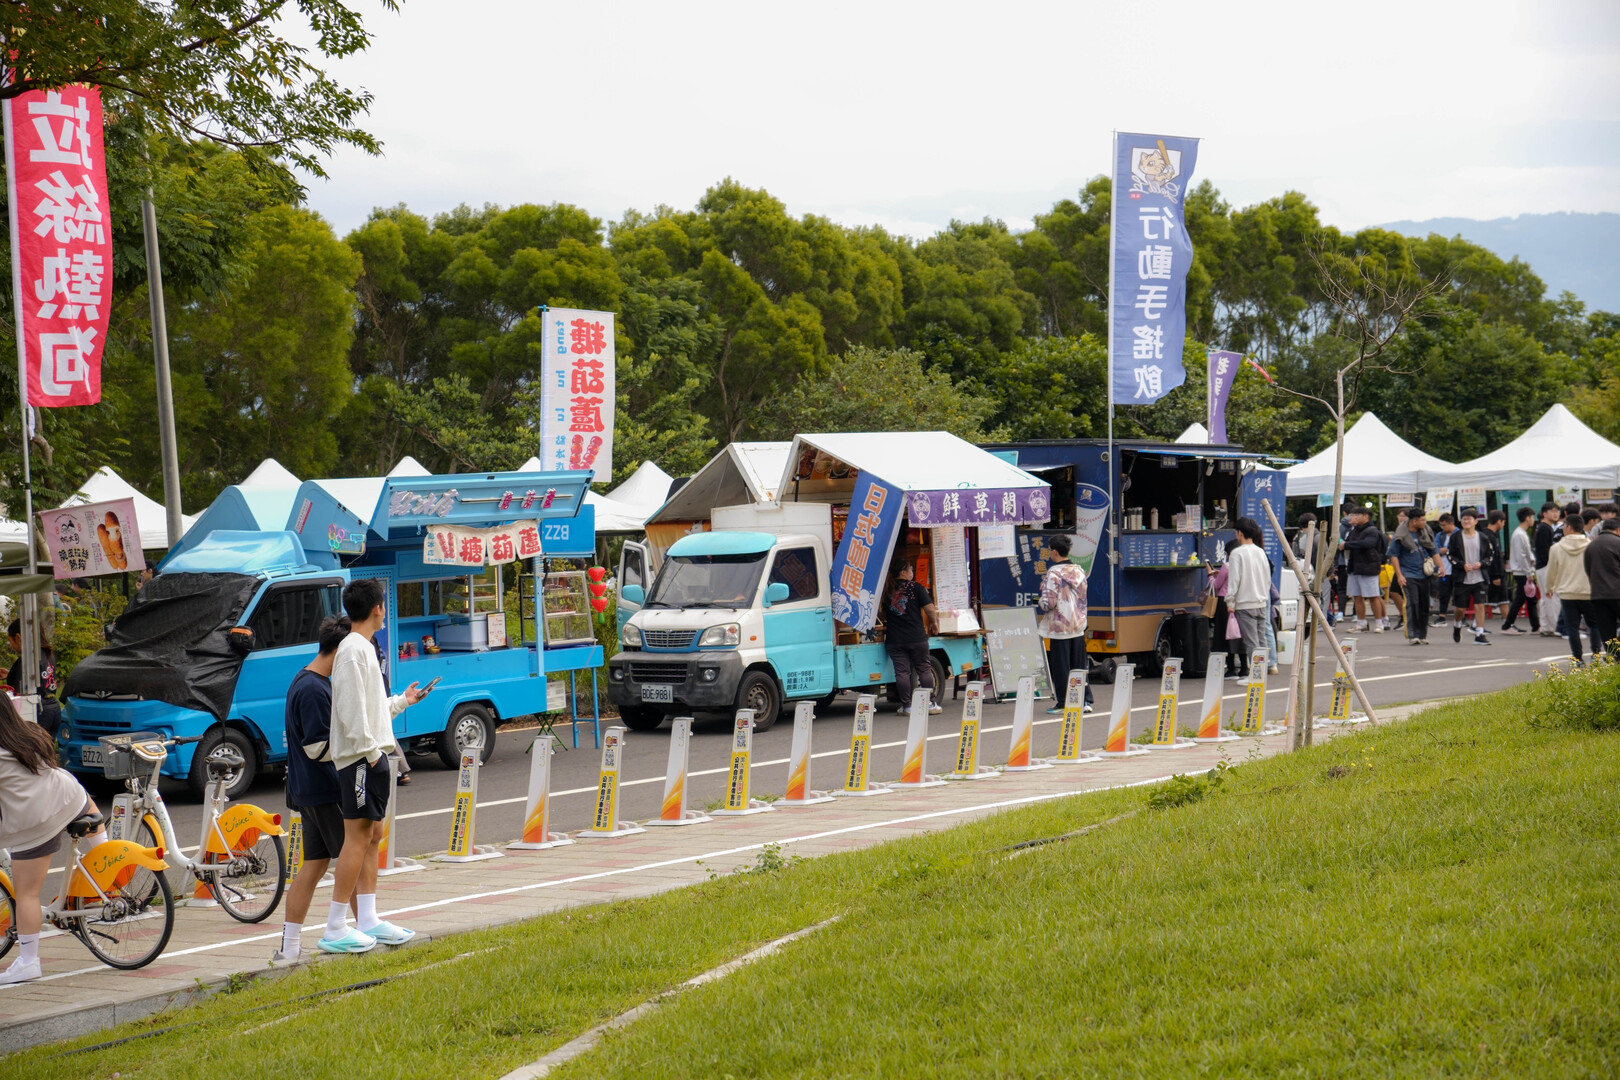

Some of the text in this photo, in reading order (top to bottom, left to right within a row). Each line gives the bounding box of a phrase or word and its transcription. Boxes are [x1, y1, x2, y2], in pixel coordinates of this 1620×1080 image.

[459, 527, 541, 563] 糖葫蘆
[840, 482, 887, 599] 日式咖哩
[642, 687, 672, 700] BDE-9881
